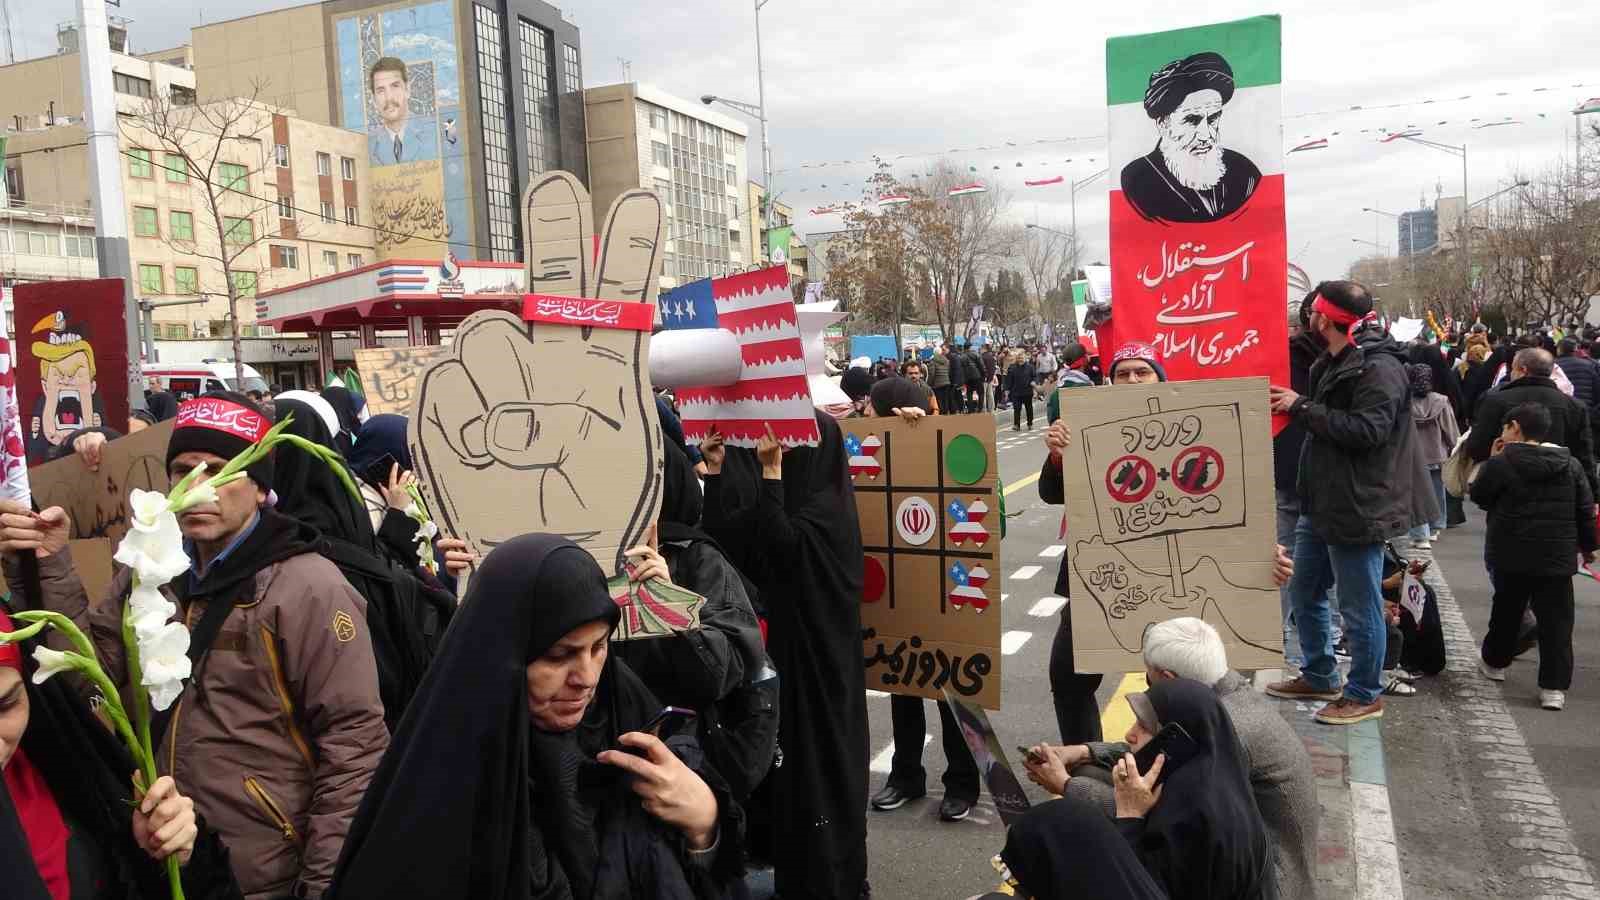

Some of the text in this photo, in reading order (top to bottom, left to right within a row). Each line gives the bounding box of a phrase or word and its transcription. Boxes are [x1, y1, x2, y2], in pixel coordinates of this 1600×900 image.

[1137, 241, 1255, 287] استقلال،
[1156, 268, 1239, 325] آزادی،
[1197, 329, 1259, 365] جمهوری
[1120, 415, 1202, 453] ورود
[1112, 490, 1222, 535] ممنوع!
[1090, 561, 1149, 619] خلیج فارس
